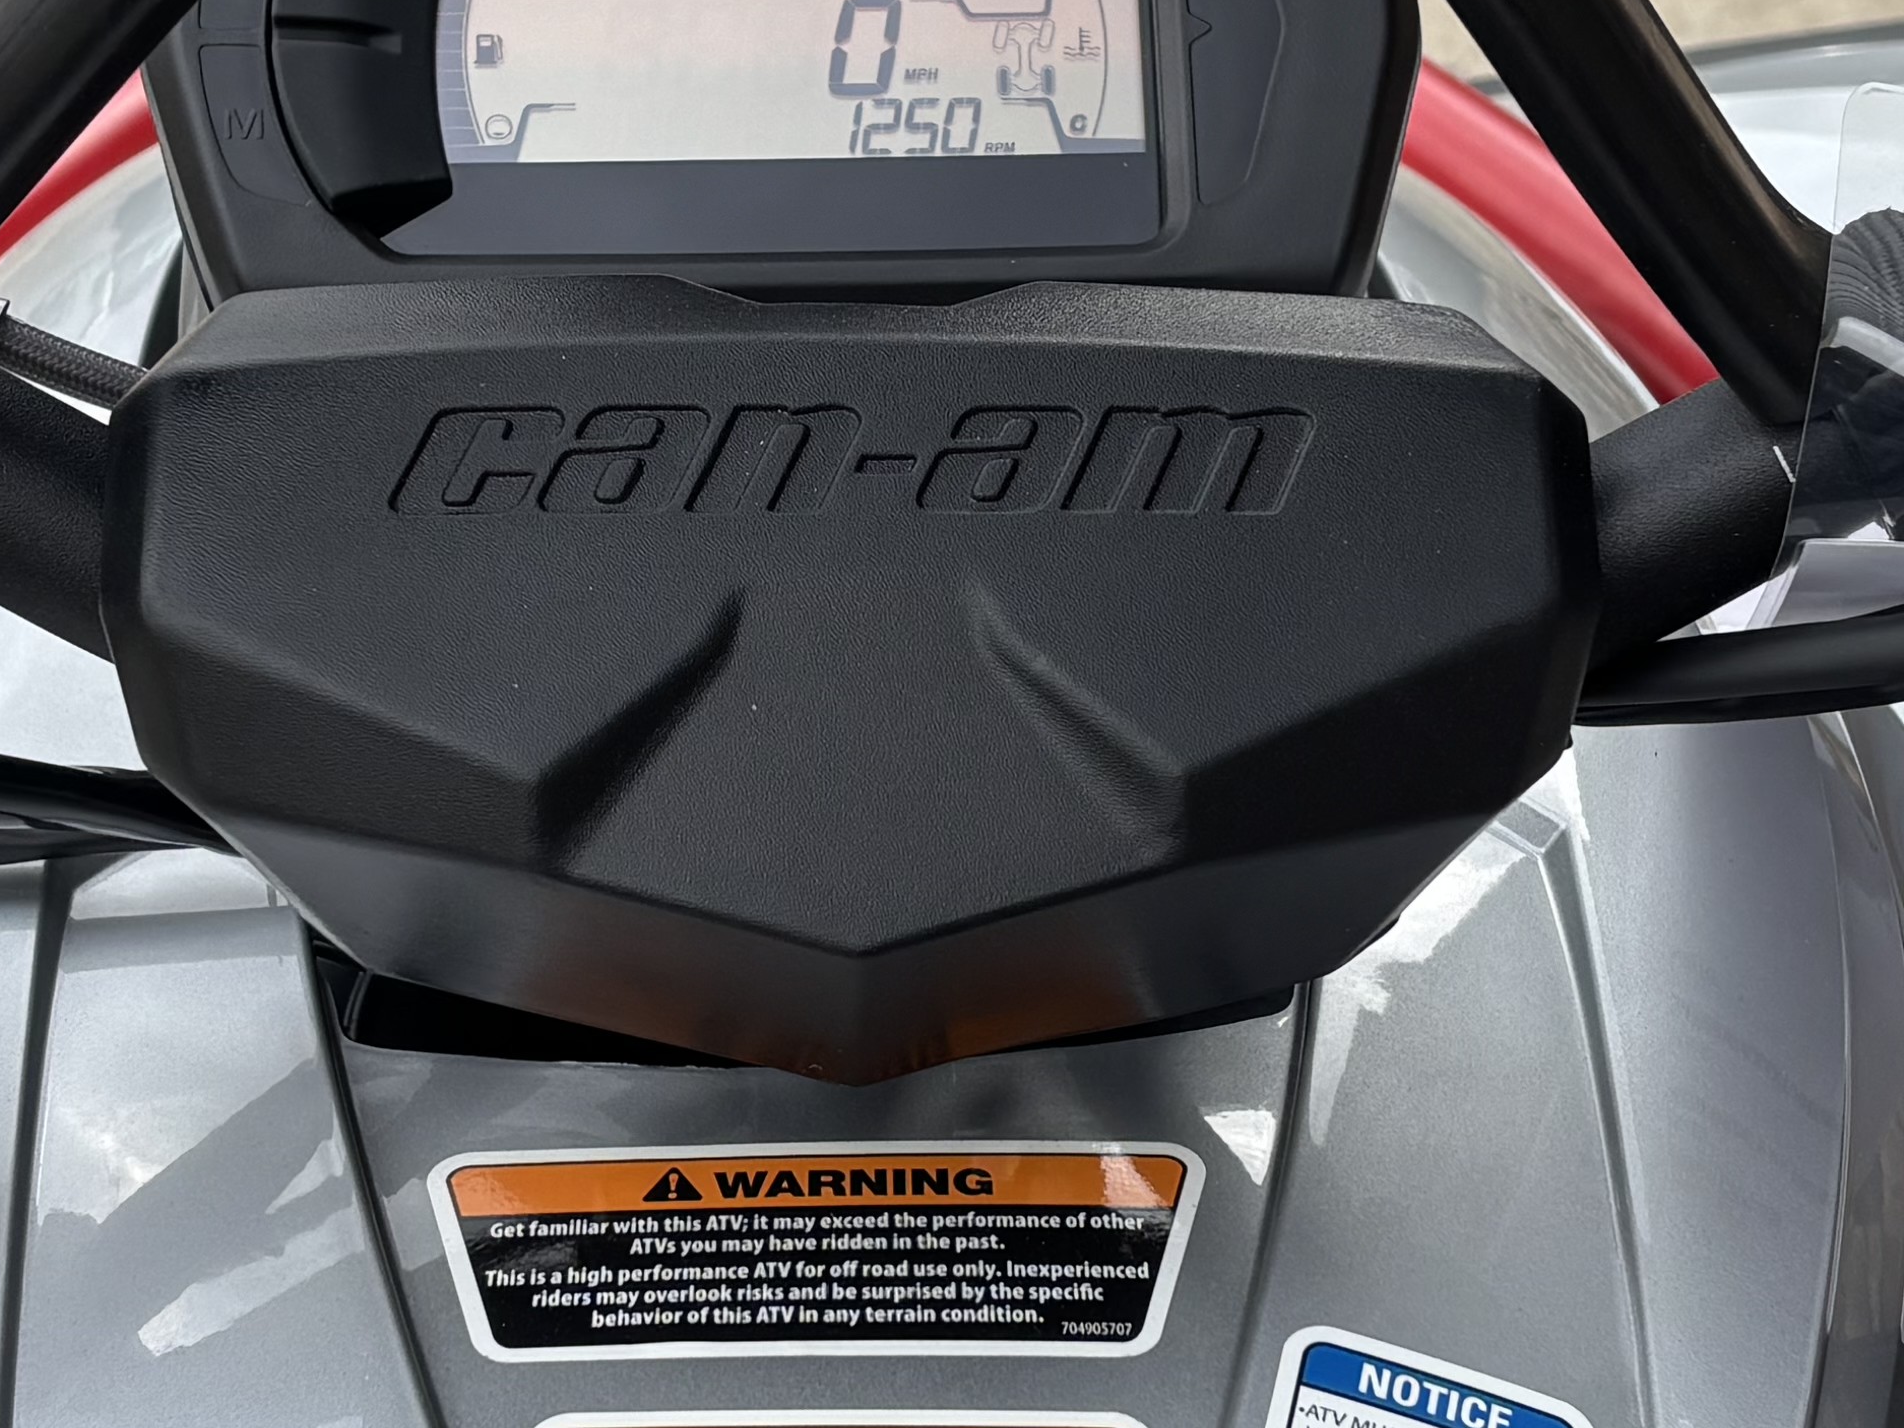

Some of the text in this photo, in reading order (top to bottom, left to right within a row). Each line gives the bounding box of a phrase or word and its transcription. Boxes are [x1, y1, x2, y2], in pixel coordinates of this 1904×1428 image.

[903, 68, 939, 83] MPH
[849, 97, 1016, 155] 1250 RPM
[388, 403, 1316, 516] can-am
[713, 1167, 993, 1198] WARNING
[489, 1219, 524, 1238] Get
[528, 1218, 609, 1236] familiar
[612, 1216, 658, 1233] with
[663, 1215, 701, 1232] this
[753, 1213, 768, 1229] it
[773, 1216, 815, 1232] may
[820, 1211, 888, 1228] exceed
[894, 1211, 927, 1227] the
[932, 1211, 1060, 1230] performance
[1065, 1212, 1086, 1228] of
[1090, 1212, 1144, 1230] other
[629, 1232, 1004, 1256] ATVs you may have ridden in the past.
[484, 1259, 1149, 1287] This is a high performance ATV for off road use only. Inexperienced
[1306, 1403, 1347, 1426] ATV
